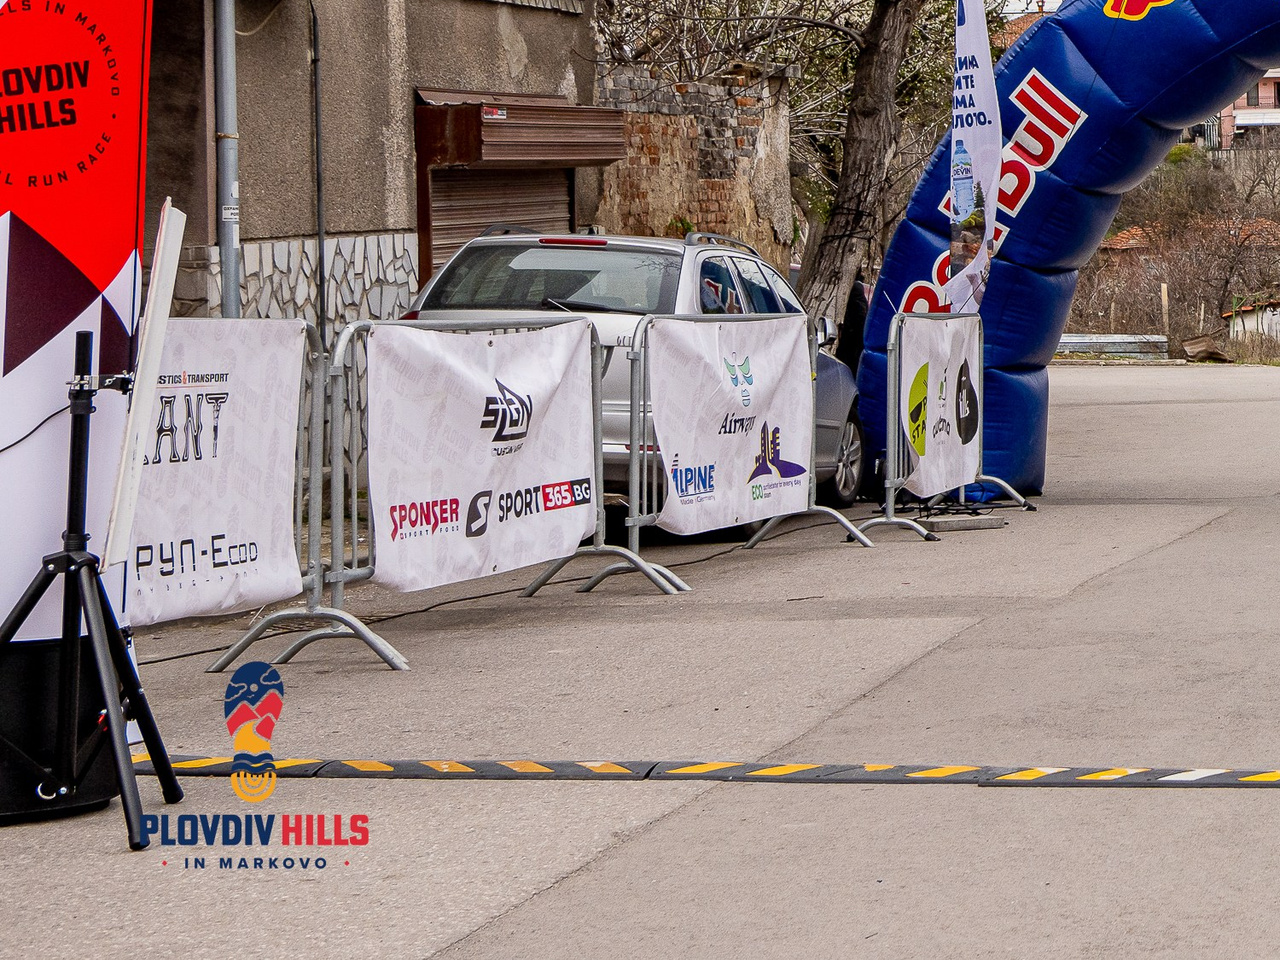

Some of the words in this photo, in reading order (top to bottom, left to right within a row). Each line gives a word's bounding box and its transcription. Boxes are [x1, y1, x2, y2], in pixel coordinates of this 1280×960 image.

[45, 0, 66, 15] IN
[74, 11, 120, 97] MARKOVO
[0, 60, 90, 98] OVDIV
[0, 97, 77, 135] HILLS
[28, 170, 69, 188] RUN
[76, 131, 112, 174] RACE
[997, 72, 1083, 213] Bull
[953, 166, 971, 176] DEVIN
[389, 498, 460, 542] SPONSER
